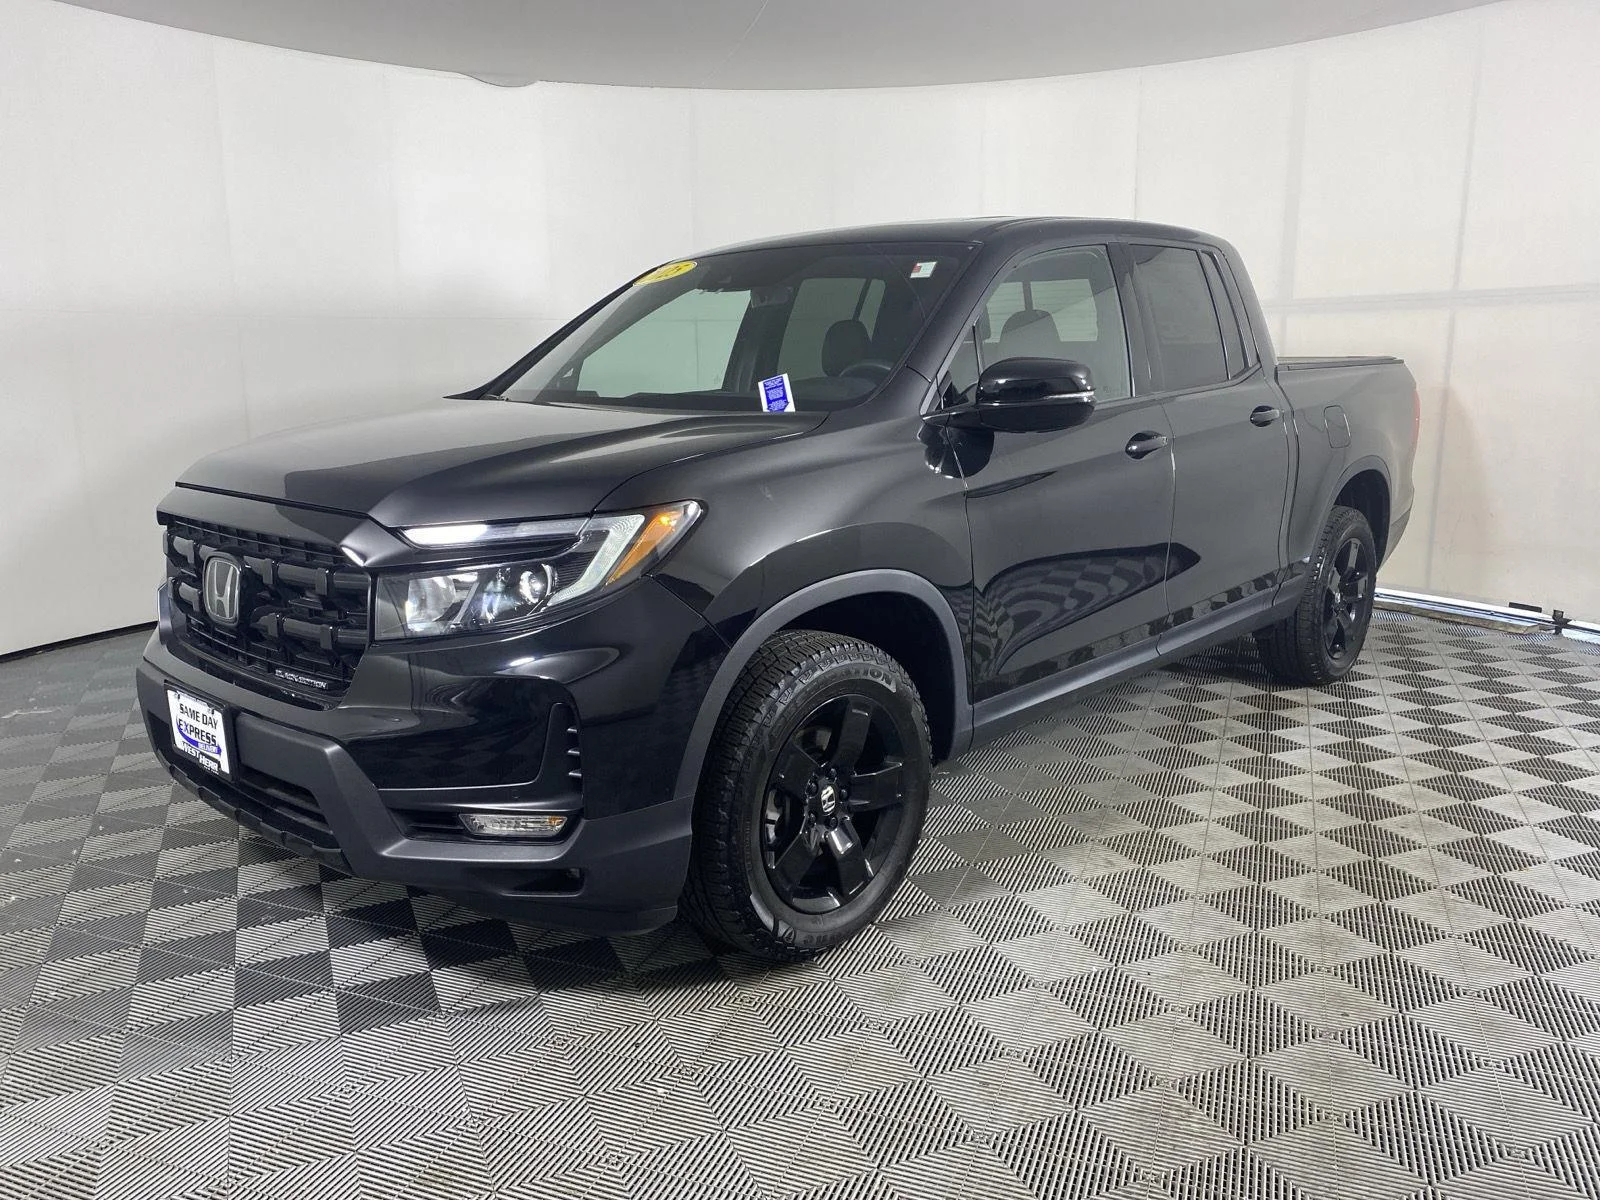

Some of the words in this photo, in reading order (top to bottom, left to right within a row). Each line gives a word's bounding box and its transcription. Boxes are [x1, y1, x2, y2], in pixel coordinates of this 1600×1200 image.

[180, 703, 201, 722] SAME
[202, 713, 219, 730] DAY
[178, 718, 217, 747] EXPRESS
[182, 740, 201, 759] WEST
[200, 755, 219, 772] HERR
